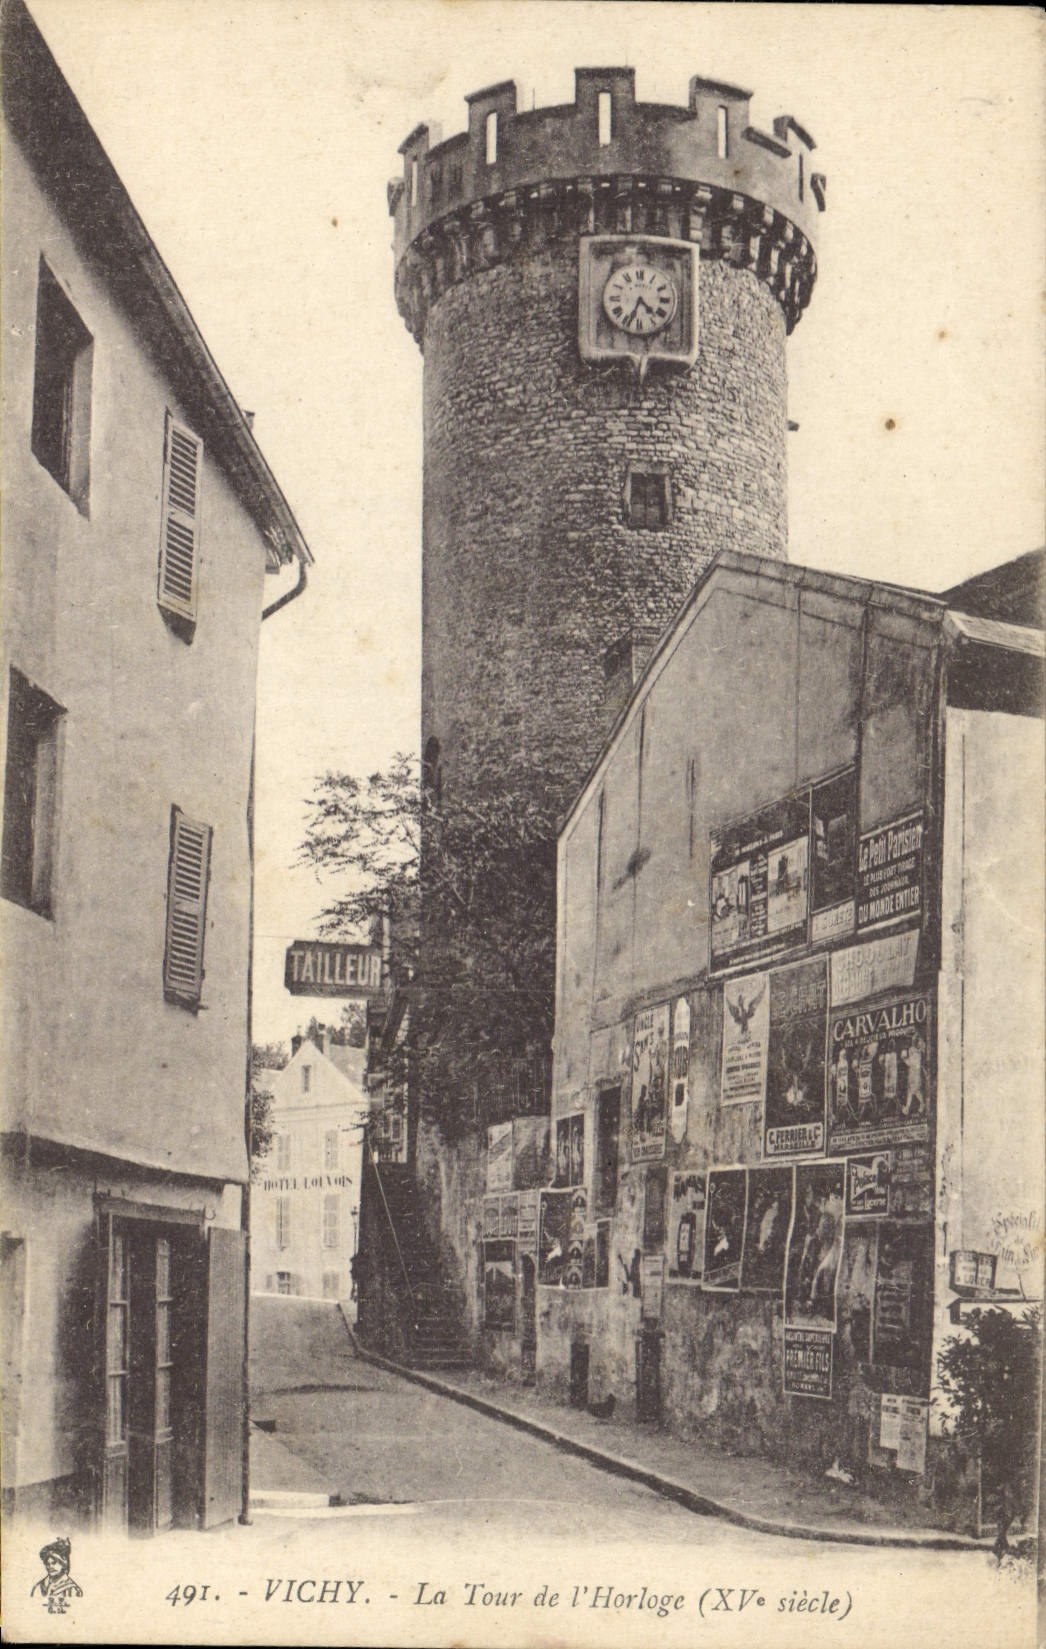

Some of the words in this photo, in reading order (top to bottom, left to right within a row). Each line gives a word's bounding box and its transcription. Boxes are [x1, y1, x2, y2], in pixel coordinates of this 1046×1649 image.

[858, 843, 869, 873] Le
[869, 834, 887, 869] Petit
[887, 823, 922, 862] Parisien
[870, 869, 883, 885] PLUS
[858, 903, 869, 924] DU
[869, 894, 894, 921] MONDE
[895, 886, 920, 911] ENTIER
[290, 950, 382, 988] TAILLEUR
[833, 1000, 927, 1042] CARVALHO
[786, 1349, 814, 1370] PREMIER
[815, 1351, 831, 1372] FILS
